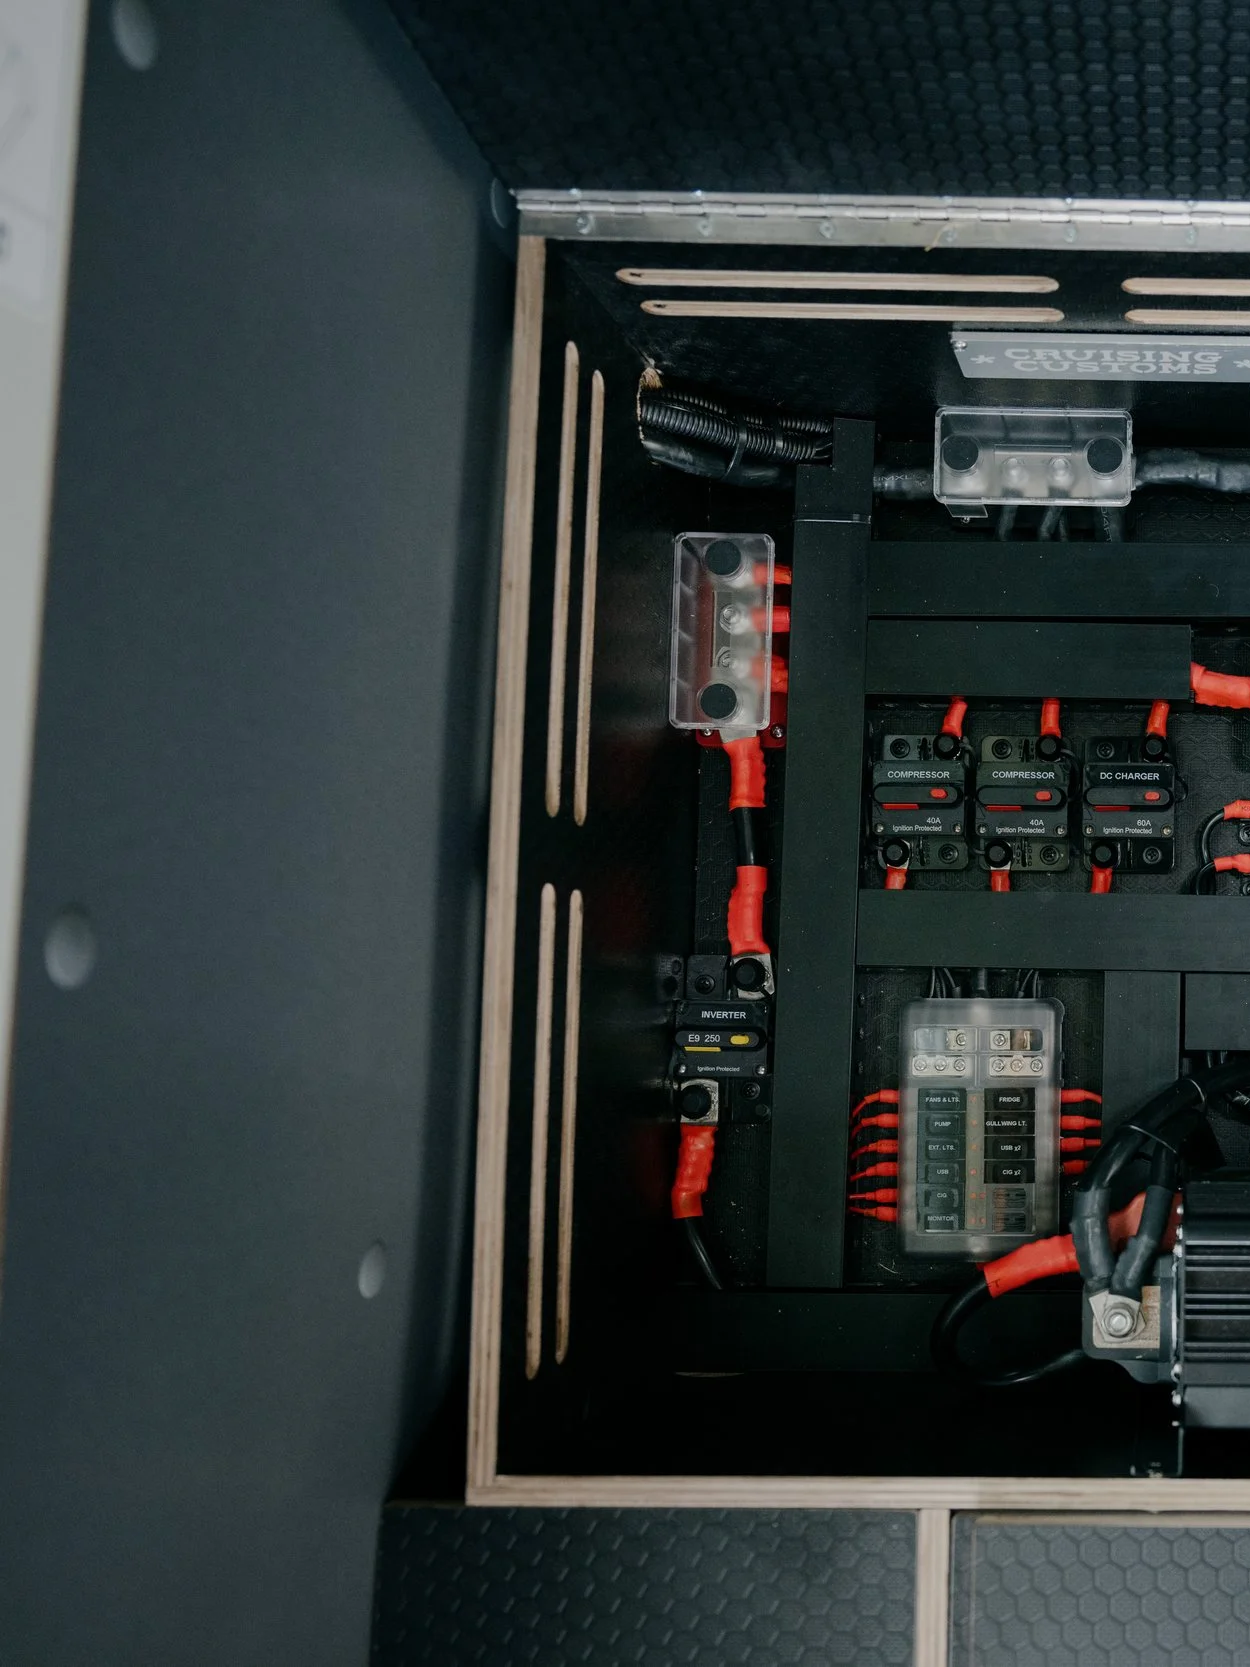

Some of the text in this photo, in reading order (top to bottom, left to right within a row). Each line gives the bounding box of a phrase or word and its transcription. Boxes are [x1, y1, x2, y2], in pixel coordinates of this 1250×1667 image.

[1003, 348, 1223, 363] CRUISING
[1013, 360, 1218, 375] CUSTOMS
[887, 771, 950, 779] COMPRESSOR
[992, 771, 1055, 779] COMPRESSOR
[1100, 772, 1160, 780] DC CHARGER
[1136, 819, 1151, 827] 60A
[996, 826, 1045, 834] Ignition Protected
[1103, 827, 1152, 835] Ignition Protected
[701, 1011, 746, 1019] INVERTER
[688, 1034, 720, 1043] E9 250
